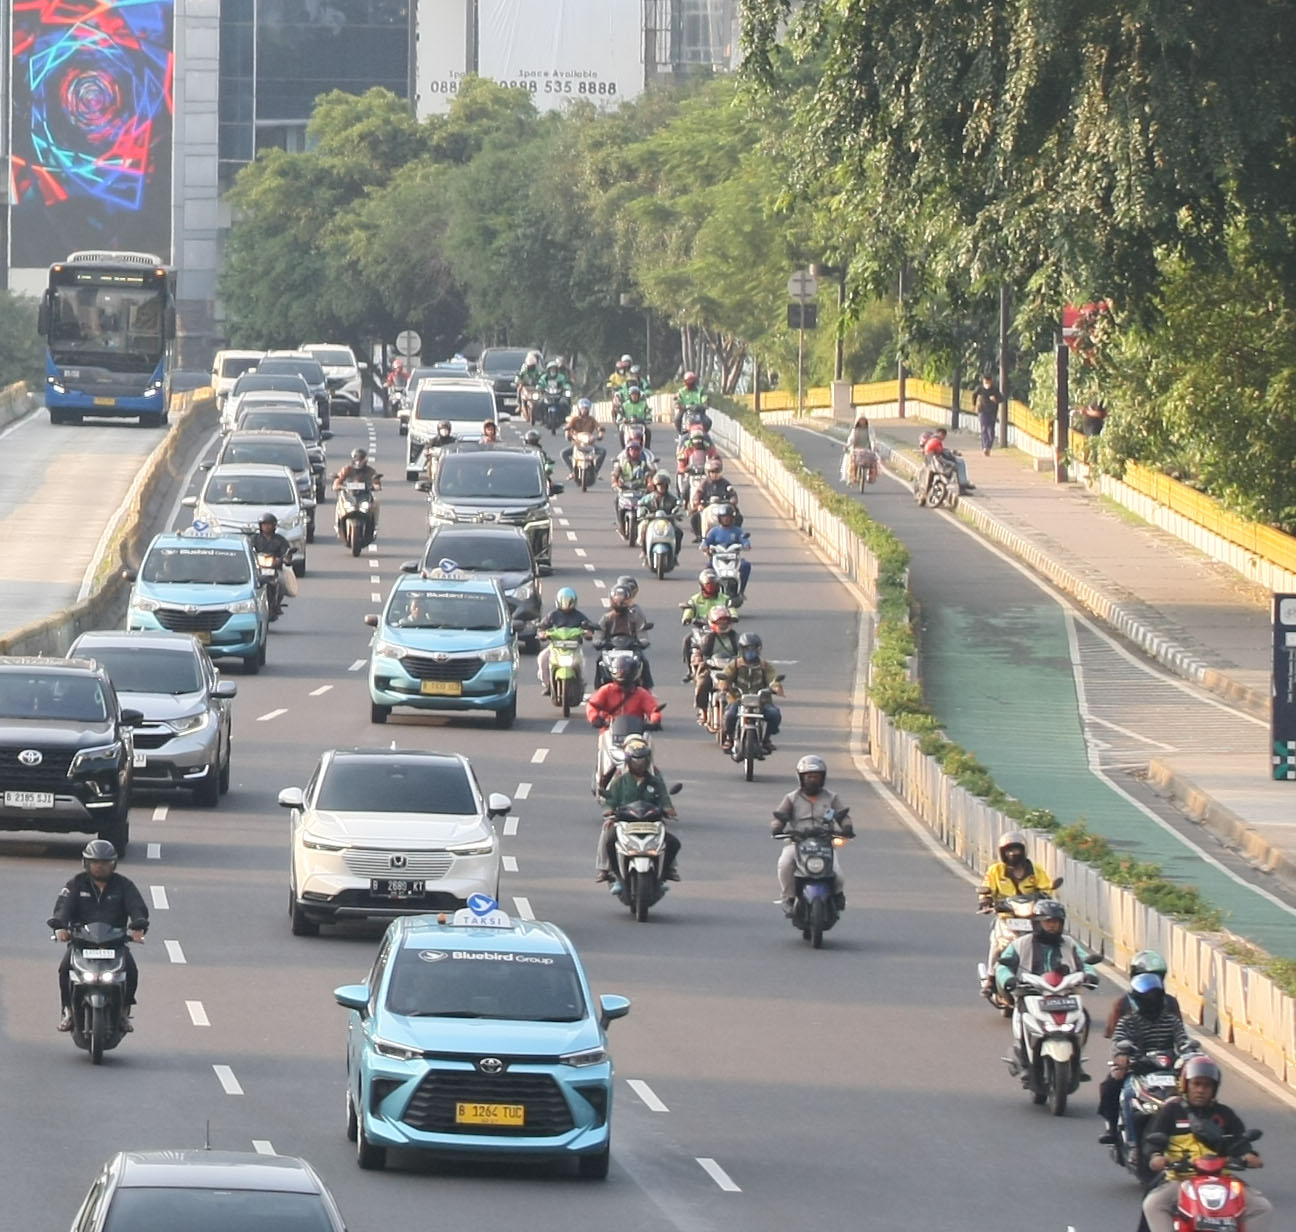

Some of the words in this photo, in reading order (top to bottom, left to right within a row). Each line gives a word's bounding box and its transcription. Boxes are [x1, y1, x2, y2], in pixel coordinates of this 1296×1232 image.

[519, 70, 549, 79] Space
[544, 80, 572, 94] 535
[578, 81, 617, 96] 8888
[463, 916, 502, 925] TAKSI
[452, 951, 514, 962] Bluebird
[515, 955, 554, 965] Group
[458, 1104, 465, 1116] B
[471, 1105, 498, 1118] 1264
[503, 1106, 522, 1118] TUC
